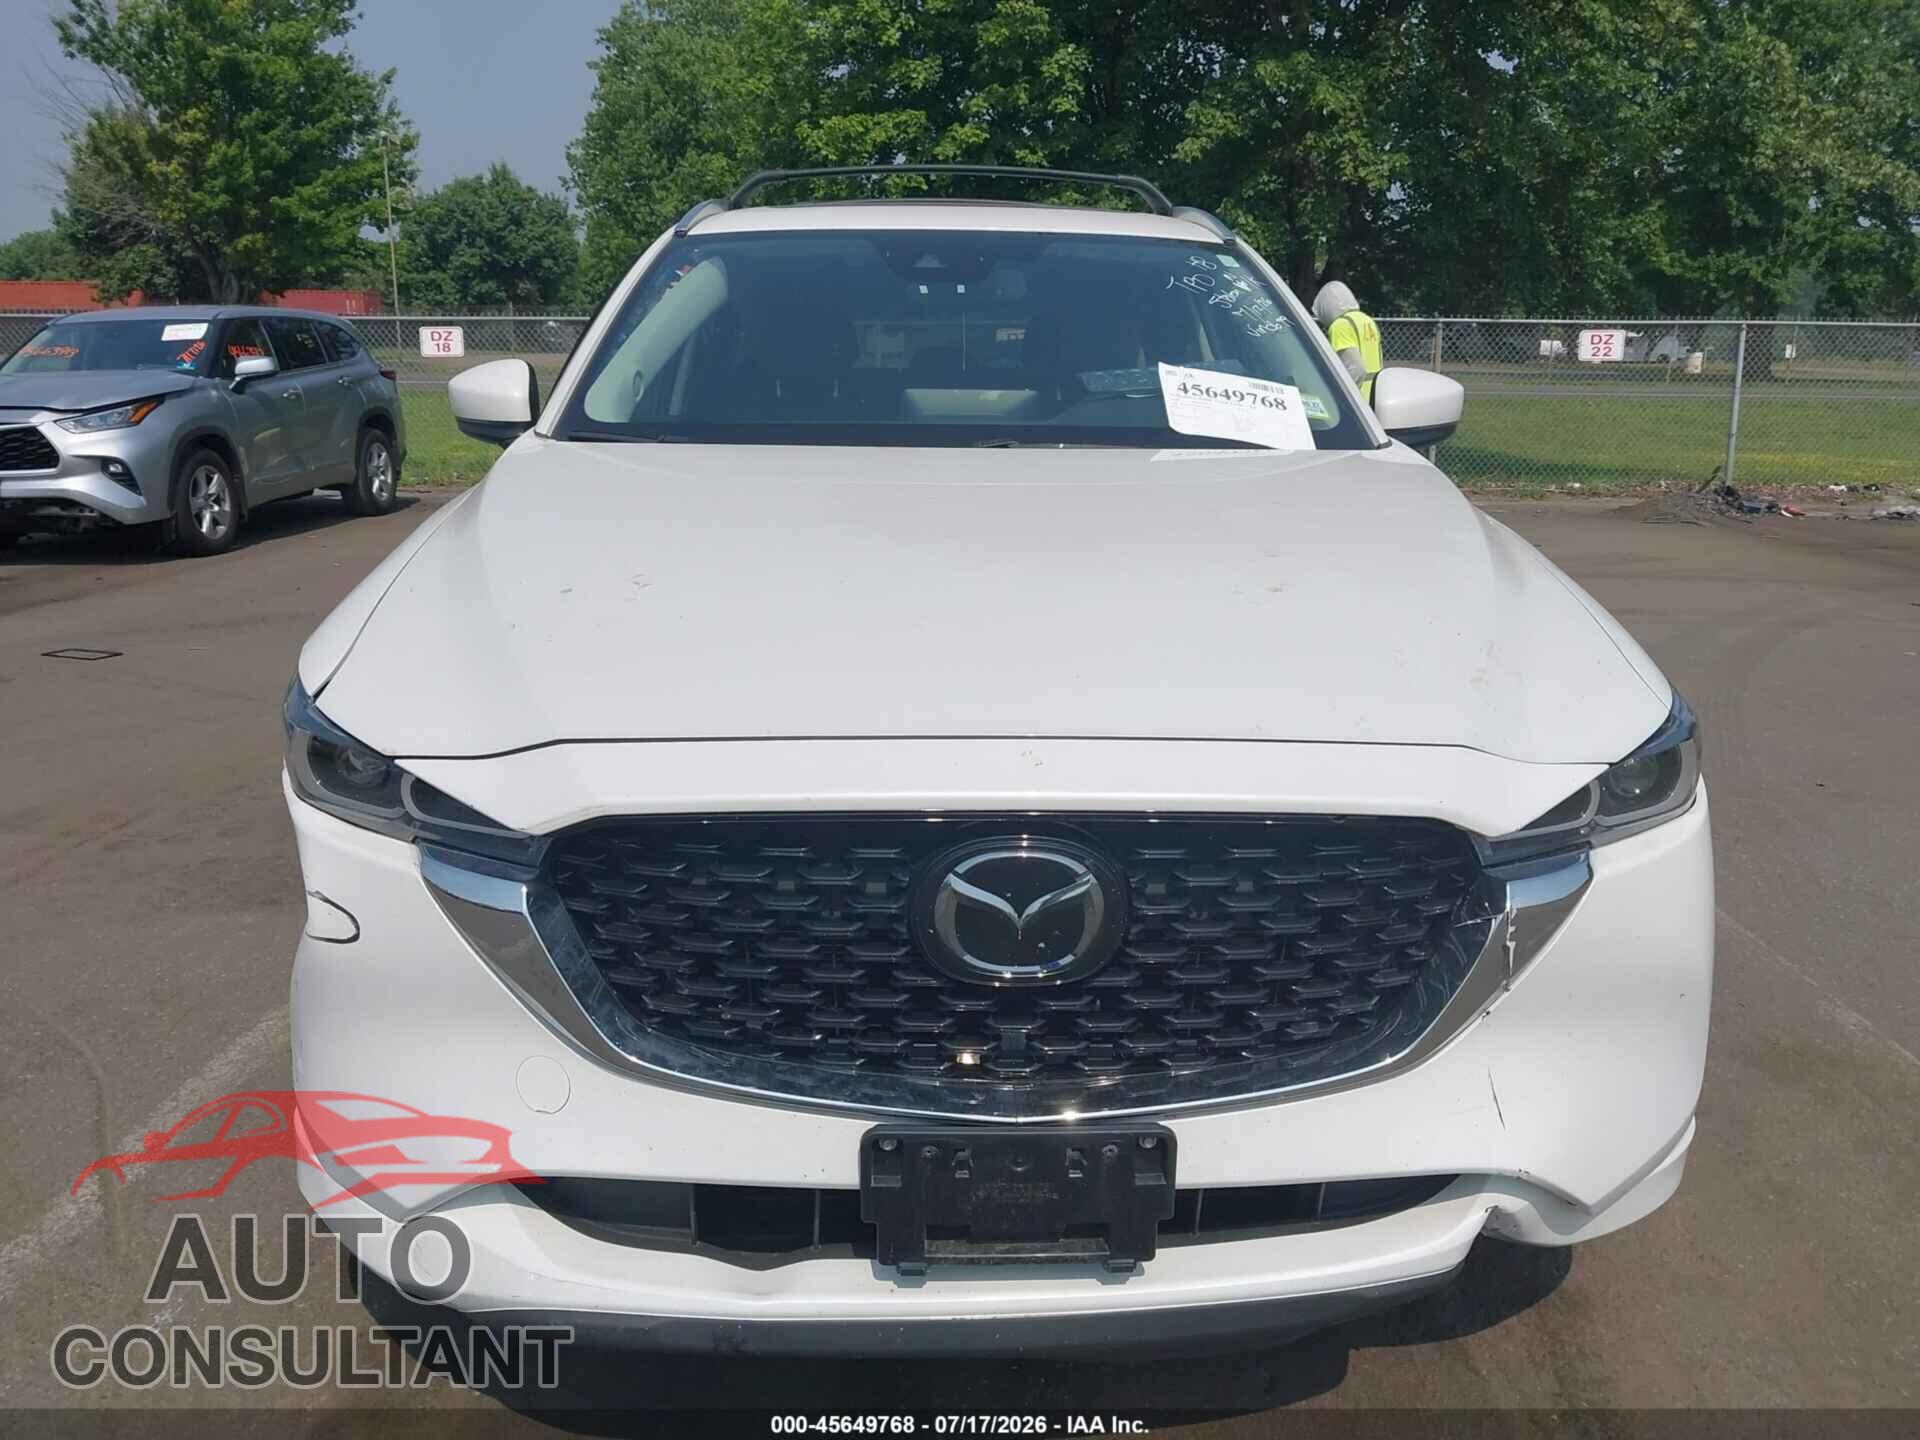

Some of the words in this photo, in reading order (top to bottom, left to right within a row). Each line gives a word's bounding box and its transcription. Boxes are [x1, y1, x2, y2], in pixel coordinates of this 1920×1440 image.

[430, 330, 454, 342] DZ
[1591, 334, 1616, 346] DZ
[434, 342, 452, 353] 18
[1591, 346, 1613, 357] 22
[1177, 381, 1288, 412] 45649768
